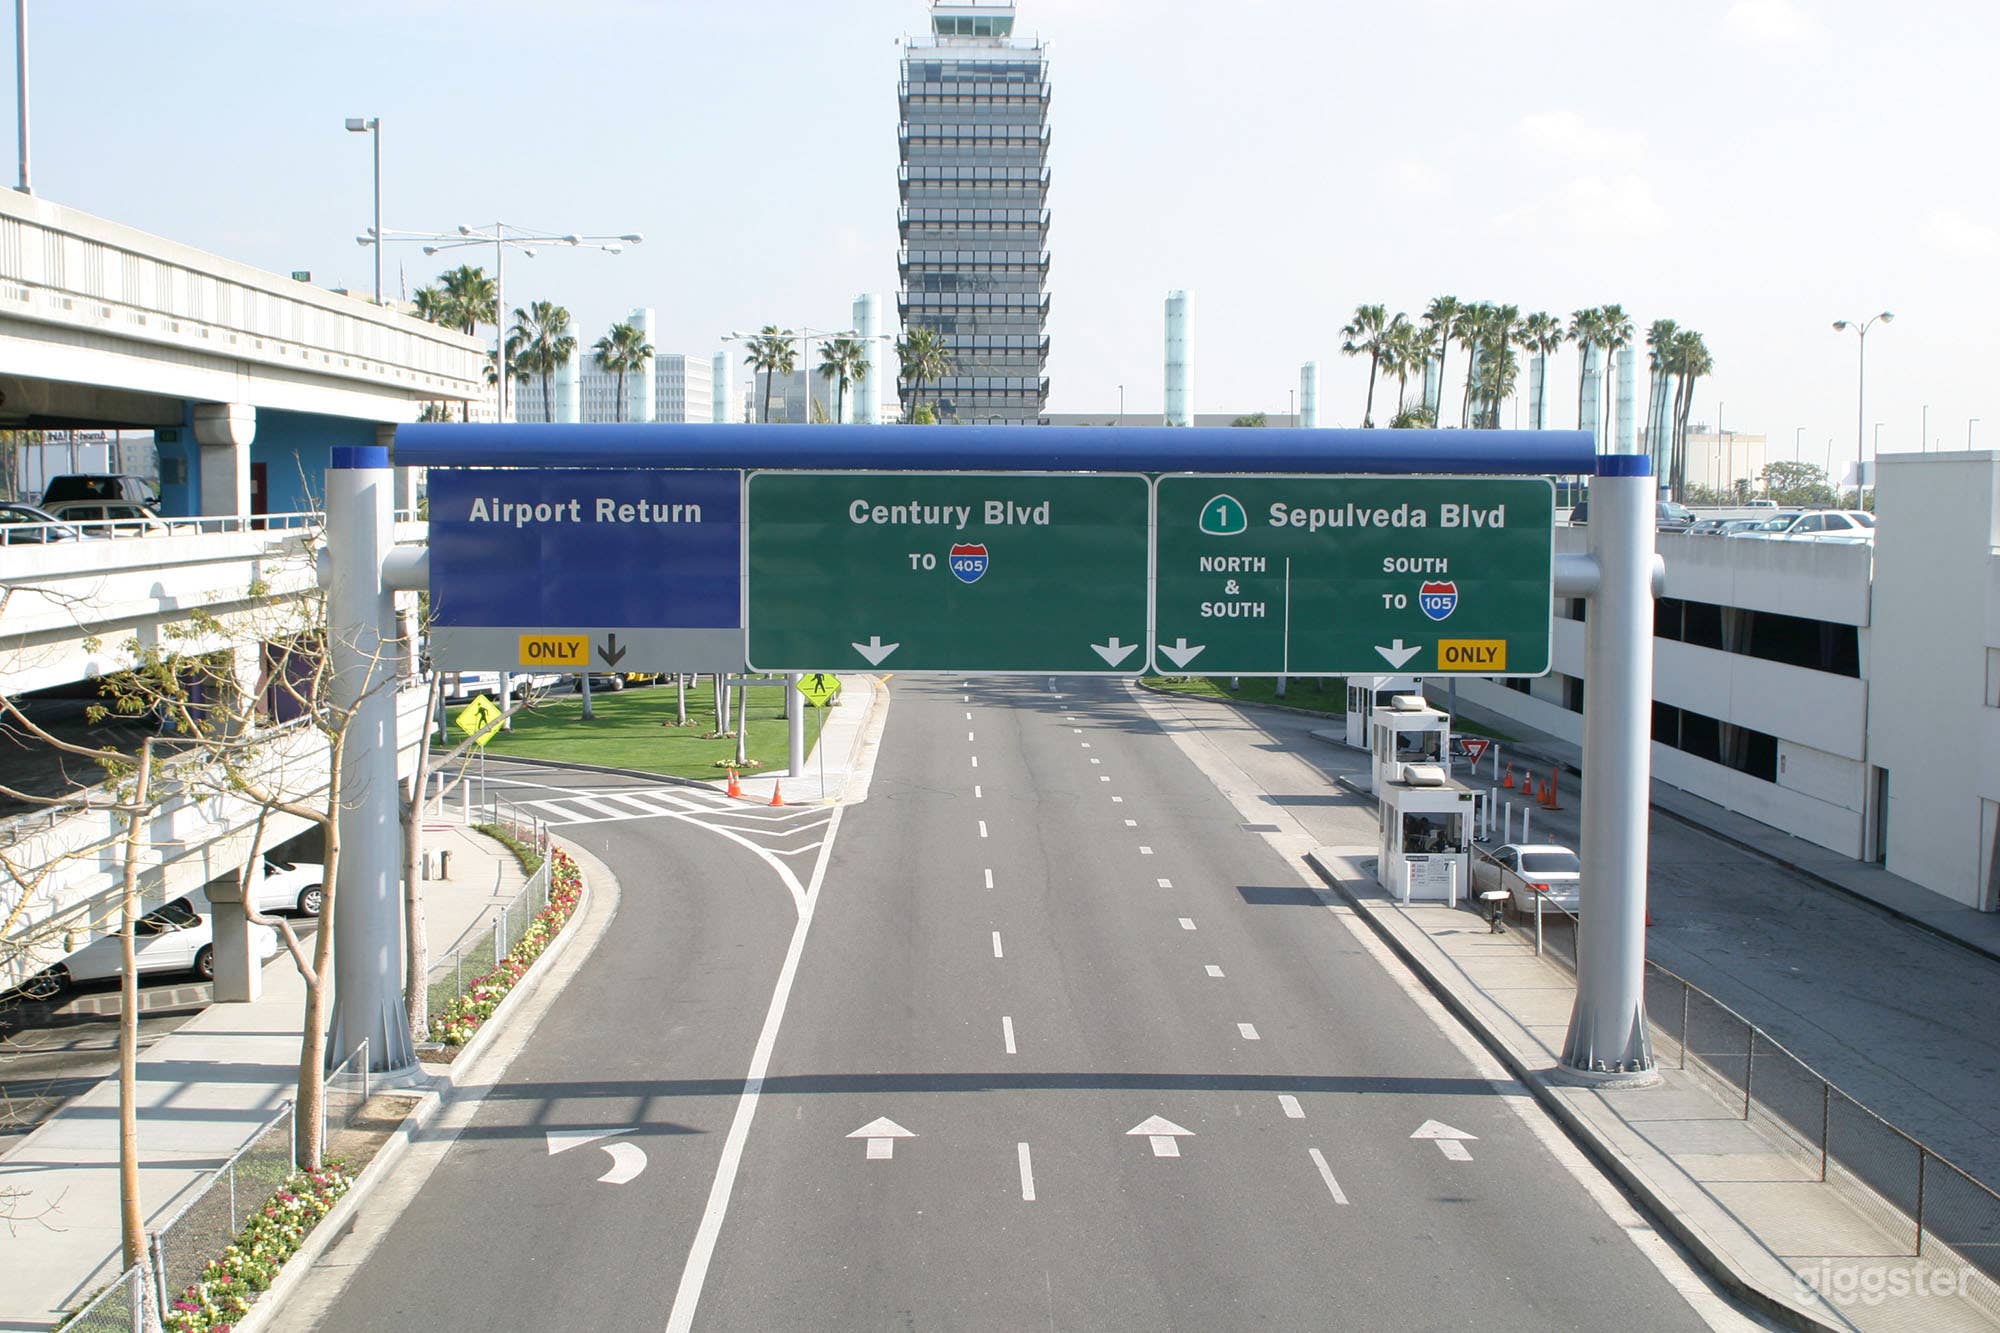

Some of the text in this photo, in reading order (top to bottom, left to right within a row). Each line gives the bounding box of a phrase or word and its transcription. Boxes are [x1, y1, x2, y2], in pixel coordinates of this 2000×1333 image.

[468, 497, 702, 528] Airport Return
[849, 500, 1050, 530] Century Blvd
[1216, 505, 1228, 526] 1
[1268, 502, 1505, 532] Sepulveda Blvd
[908, 553, 985, 573] TO 405
[1199, 556, 1266, 573] NORTH
[1382, 557, 1448, 574] SOUTH
[1224, 580, 1240, 595] &
[1200, 602, 1266, 618] SOUTH
[1382, 593, 1452, 610] TO 105
[527, 641, 581, 659] ONLY
[1445, 646, 1498, 663] ONLY
